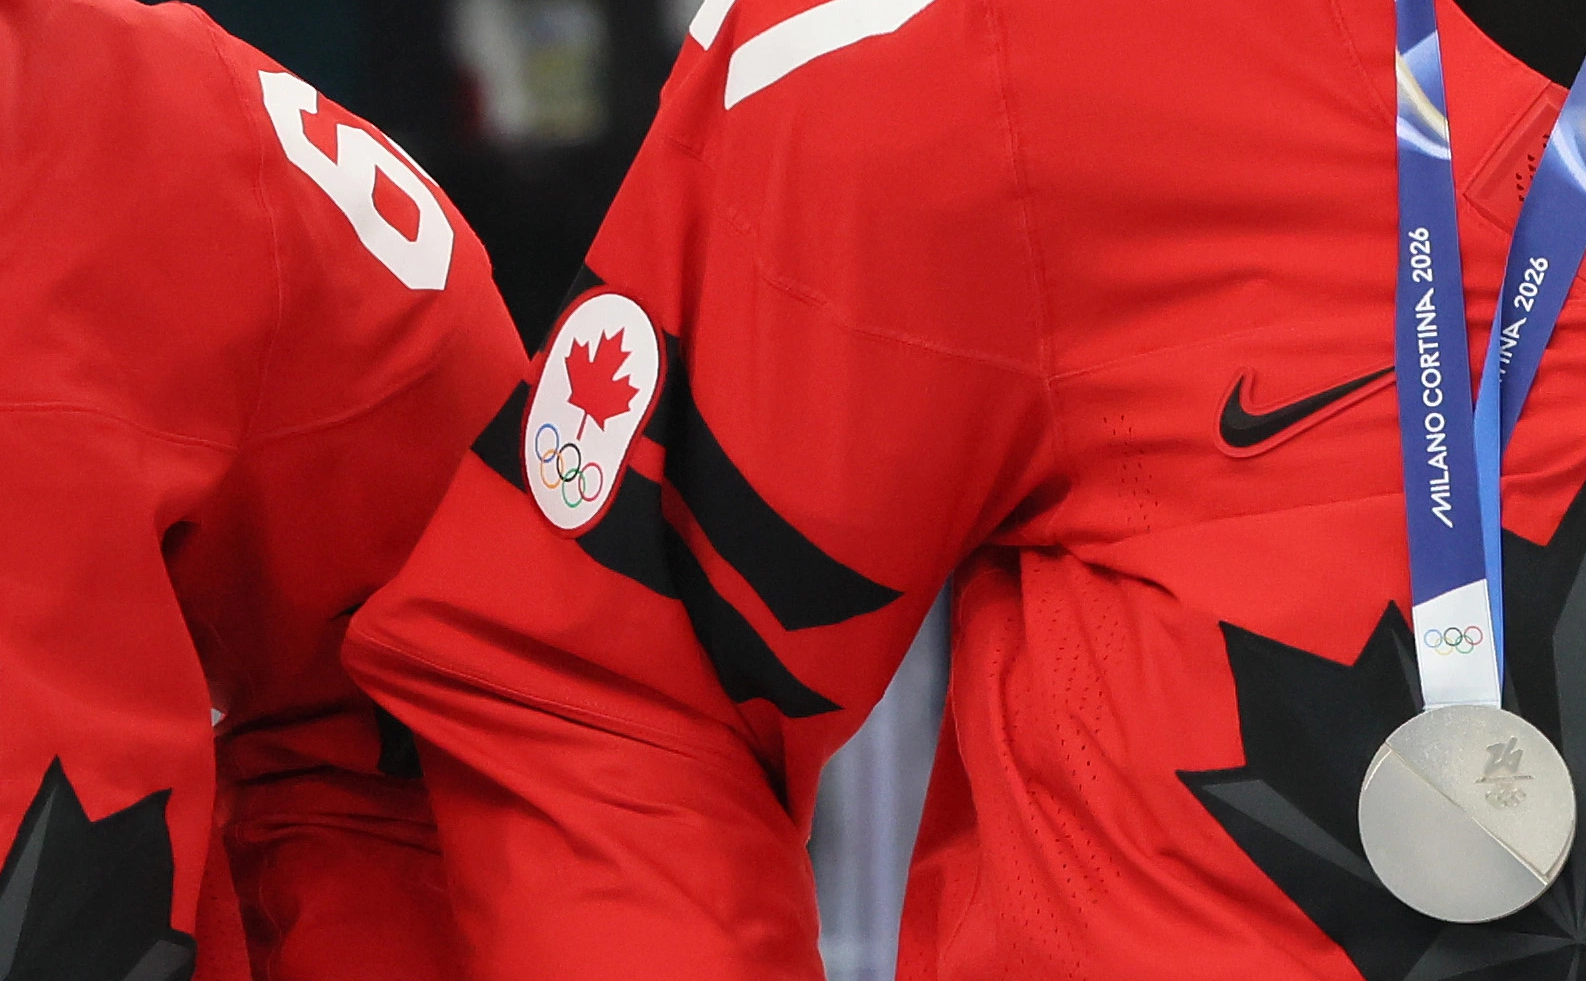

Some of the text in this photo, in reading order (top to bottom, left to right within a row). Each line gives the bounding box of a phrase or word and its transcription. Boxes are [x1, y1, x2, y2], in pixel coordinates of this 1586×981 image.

[258, 70, 455, 291] 6
[1513, 257, 1549, 313] 2026
[1408, 227, 1453, 528] MILANO CORTINA 2026
